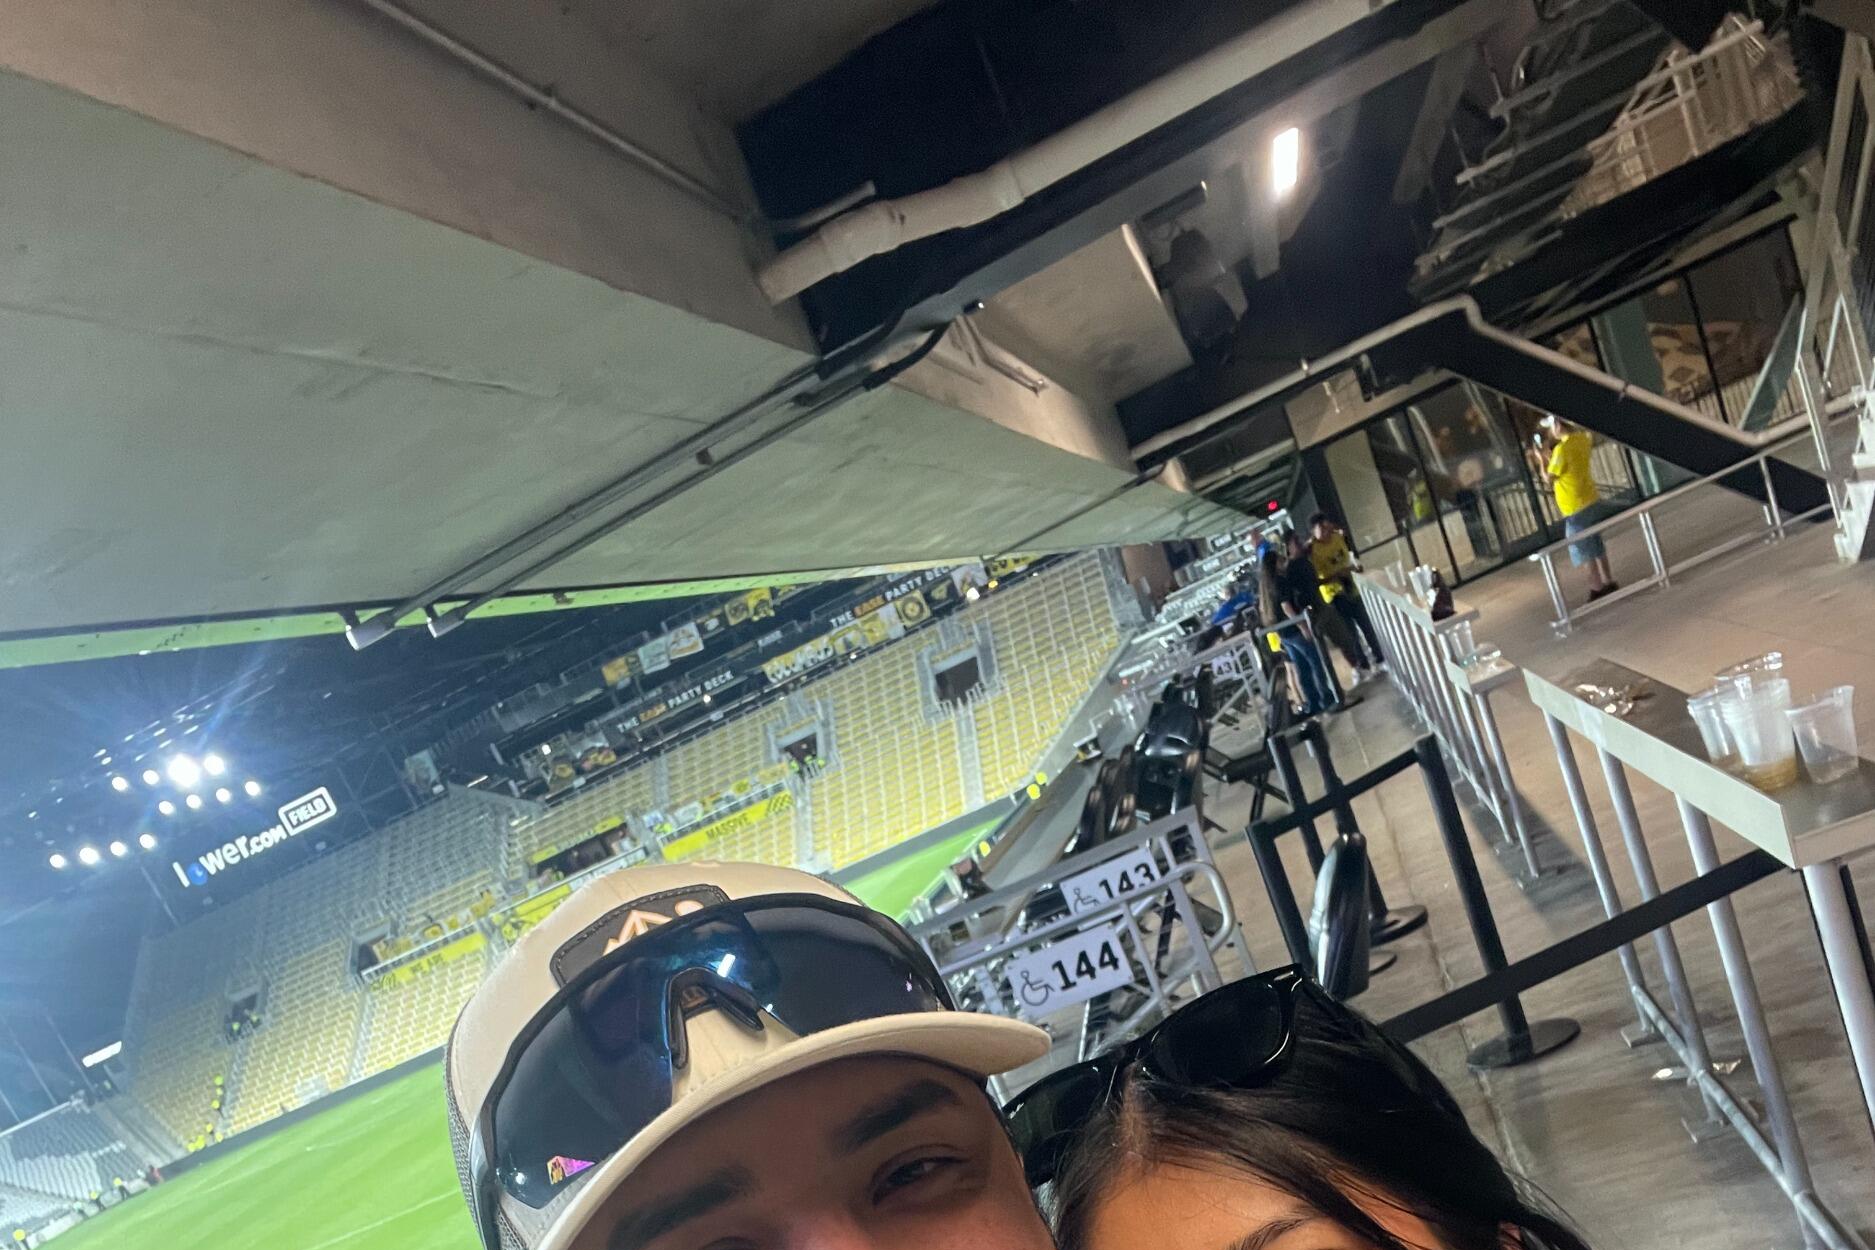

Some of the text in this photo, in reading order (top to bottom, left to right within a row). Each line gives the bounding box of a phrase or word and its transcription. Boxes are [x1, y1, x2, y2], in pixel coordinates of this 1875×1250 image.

[830, 610, 855, 628] THE
[884, 576, 922, 601] PARTY
[924, 565, 950, 581] DEC
[617, 716, 640, 733] THE
[667, 685, 702, 709] PARTY
[703, 670, 734, 691] DECK
[287, 797, 327, 827] FIELD
[1098, 861, 1156, 900] 143
[1051, 940, 1120, 991] 144
